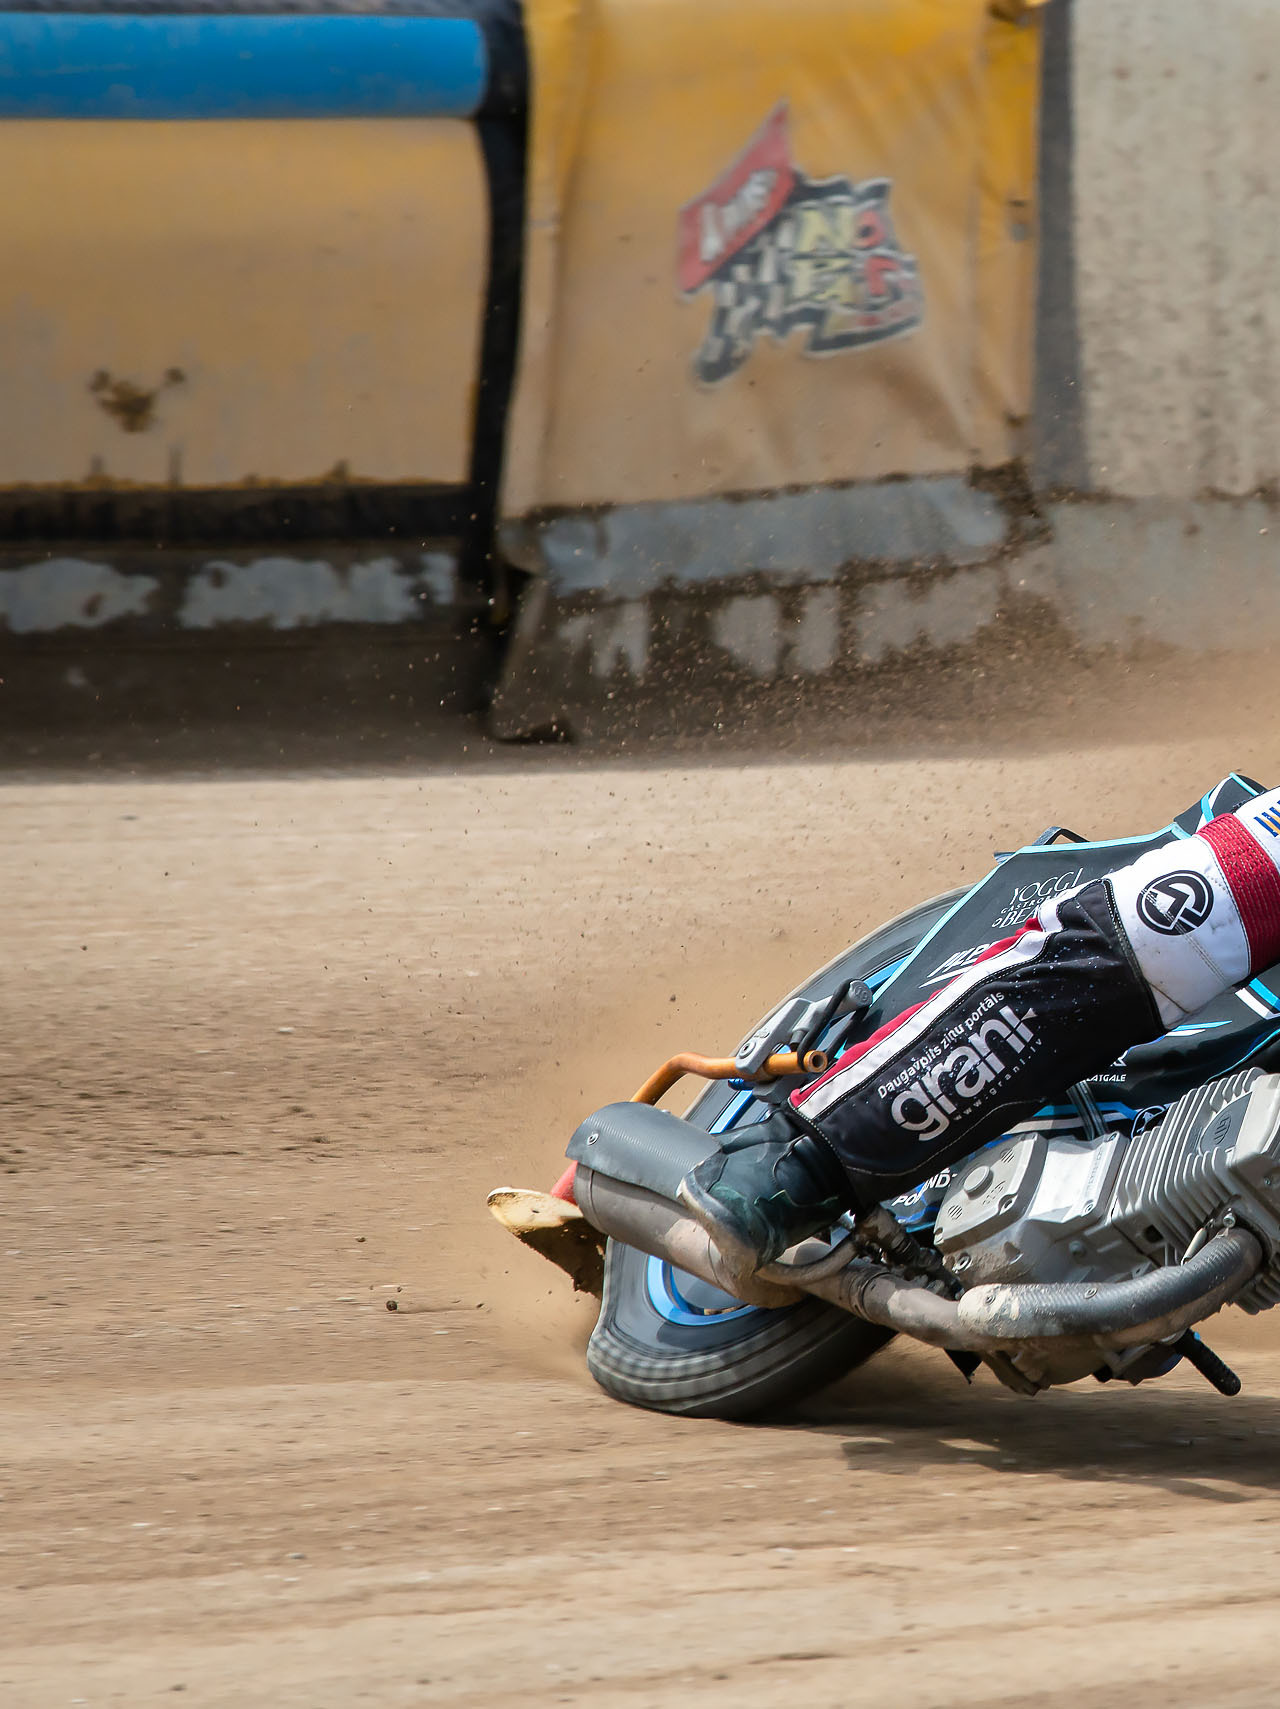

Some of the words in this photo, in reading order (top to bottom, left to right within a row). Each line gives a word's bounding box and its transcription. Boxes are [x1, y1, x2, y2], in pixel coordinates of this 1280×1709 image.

[1009, 867, 1084, 906] YOGGI
[878, 1046, 942, 1099] Daugavpils
[965, 991, 1006, 1031] portāls
